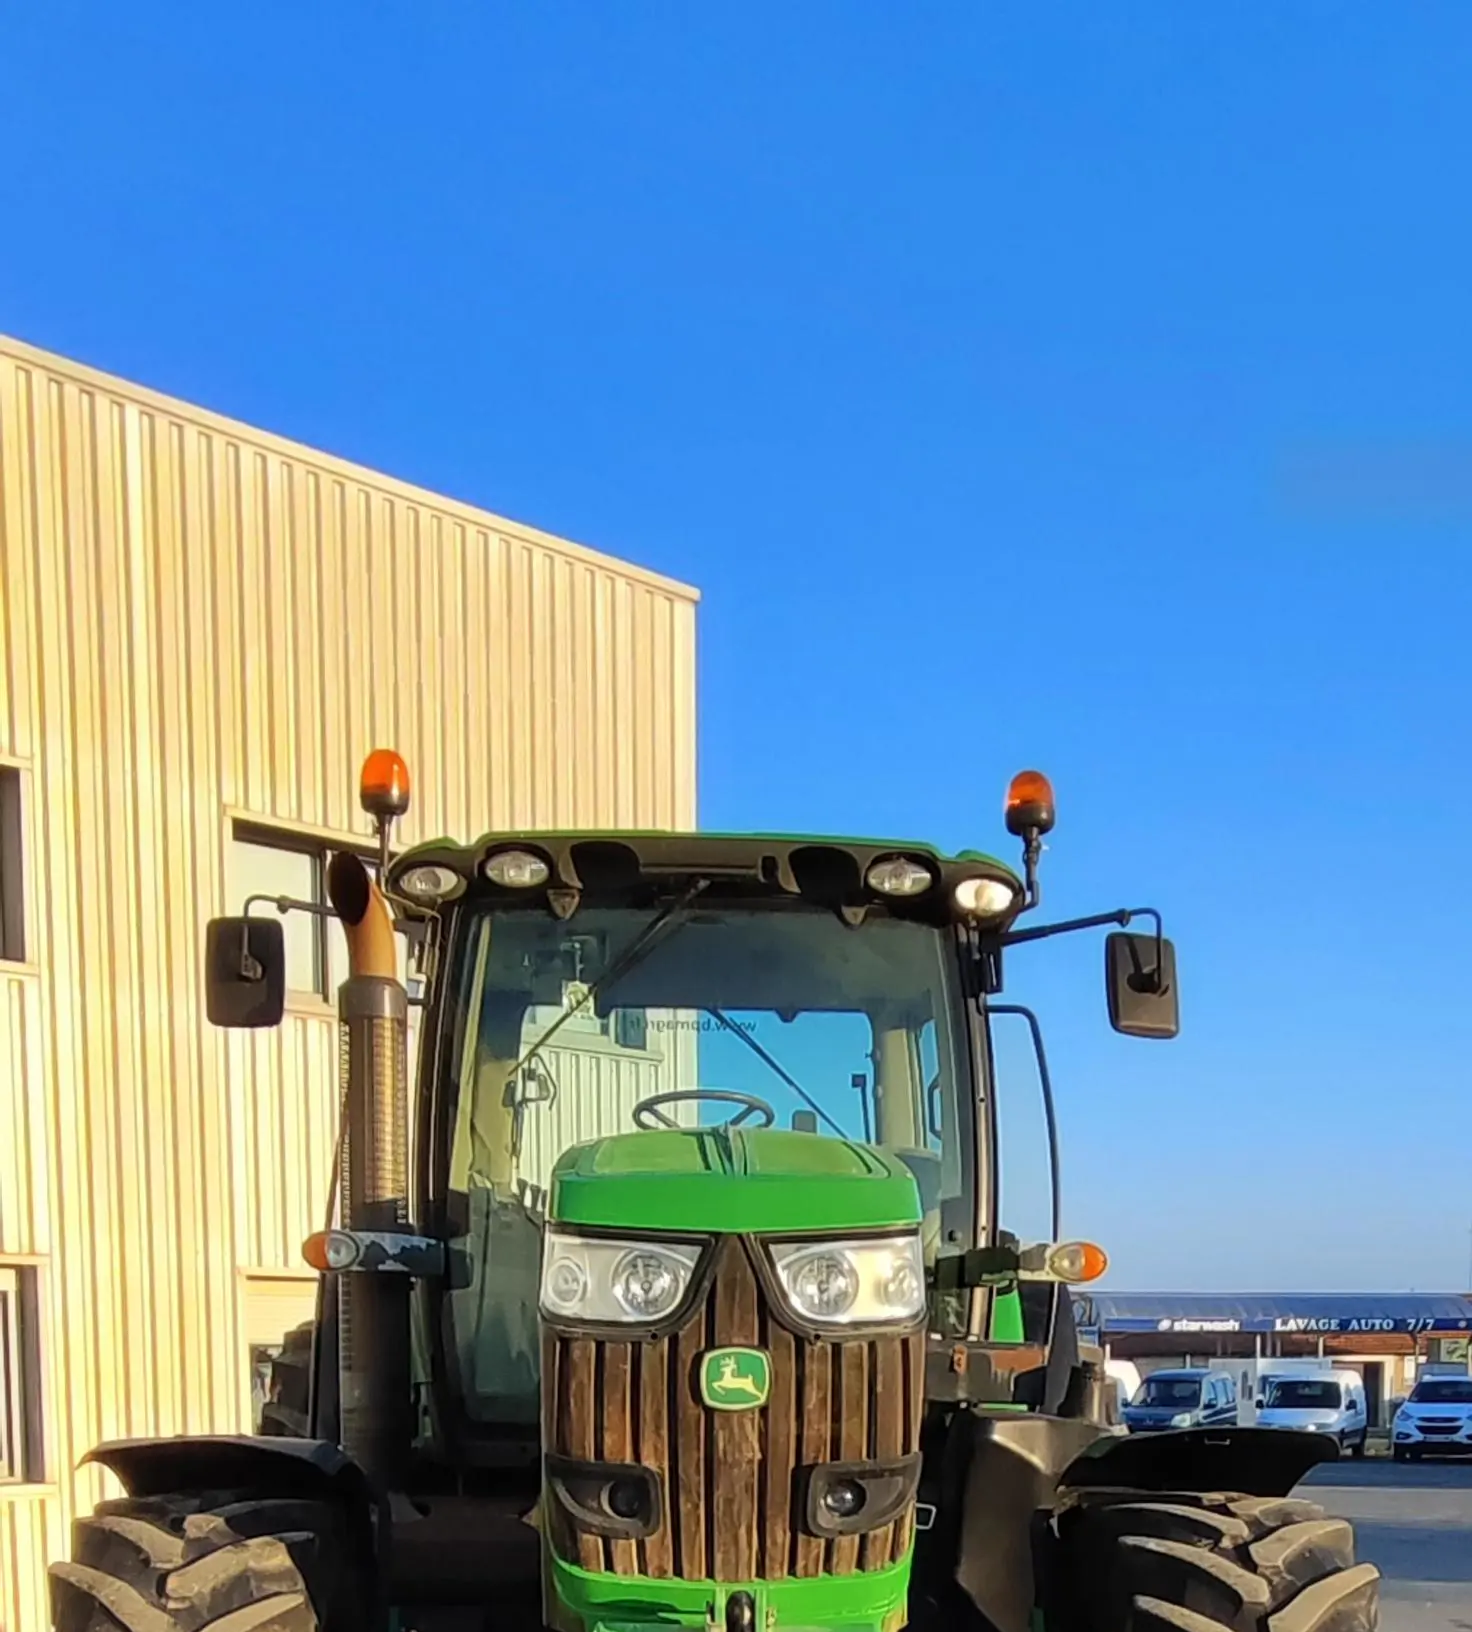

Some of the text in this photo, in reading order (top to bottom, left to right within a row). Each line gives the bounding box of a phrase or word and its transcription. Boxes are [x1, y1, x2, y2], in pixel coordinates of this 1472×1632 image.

[1275, 1317, 1435, 1331] LAVAGE AUTO 7/7
